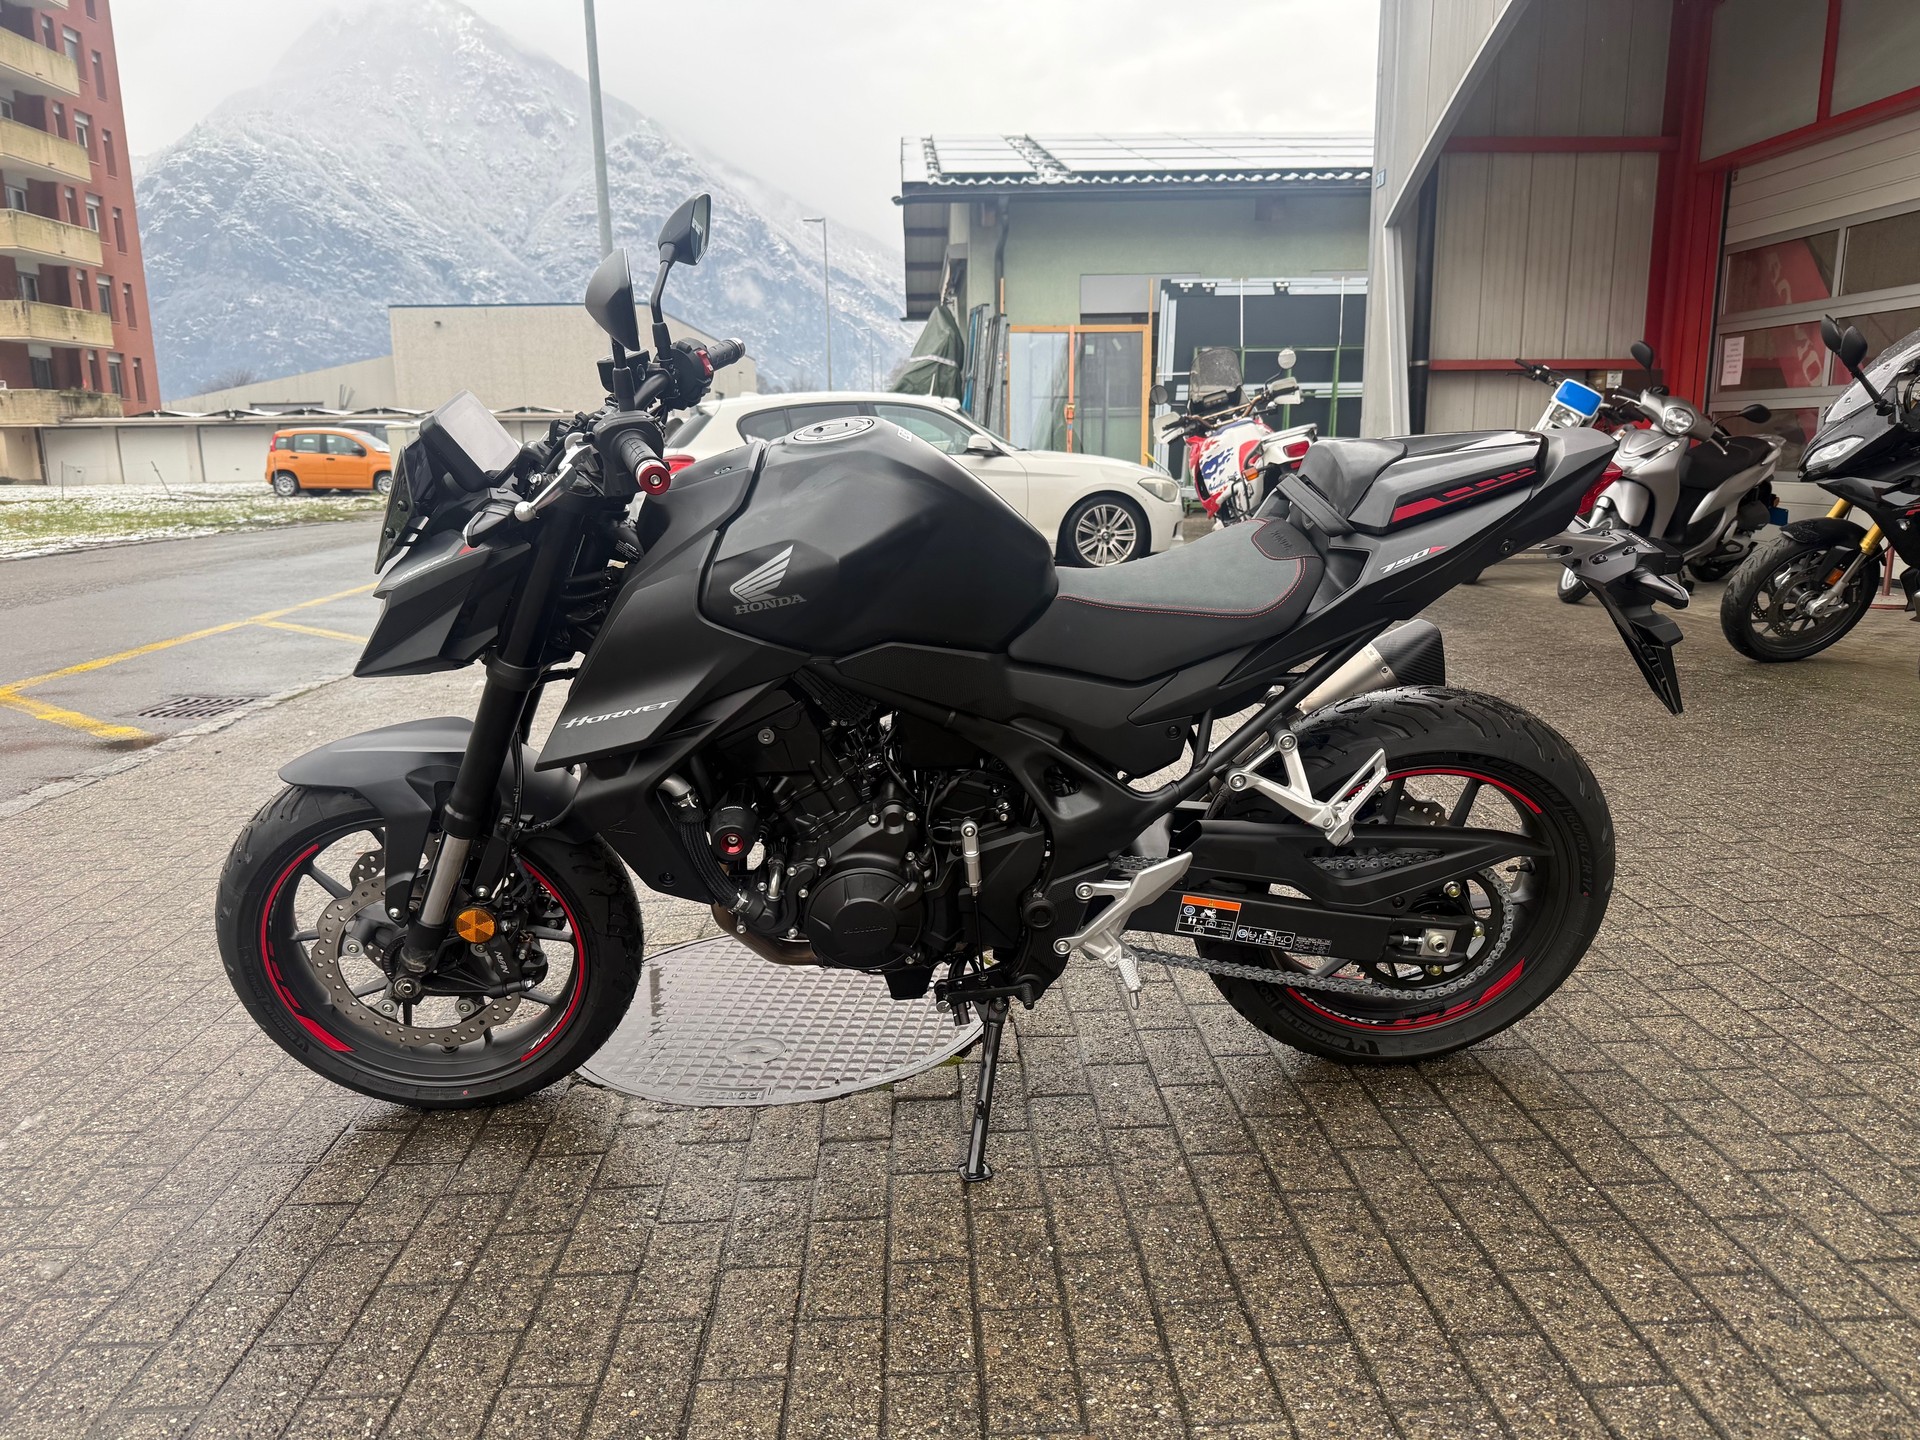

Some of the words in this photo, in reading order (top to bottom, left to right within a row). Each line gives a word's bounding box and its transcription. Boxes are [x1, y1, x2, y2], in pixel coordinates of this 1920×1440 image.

[1380, 548, 1431, 574] 750
[733, 594, 807, 615] HONDA
[561, 700, 679, 729] HORNET
